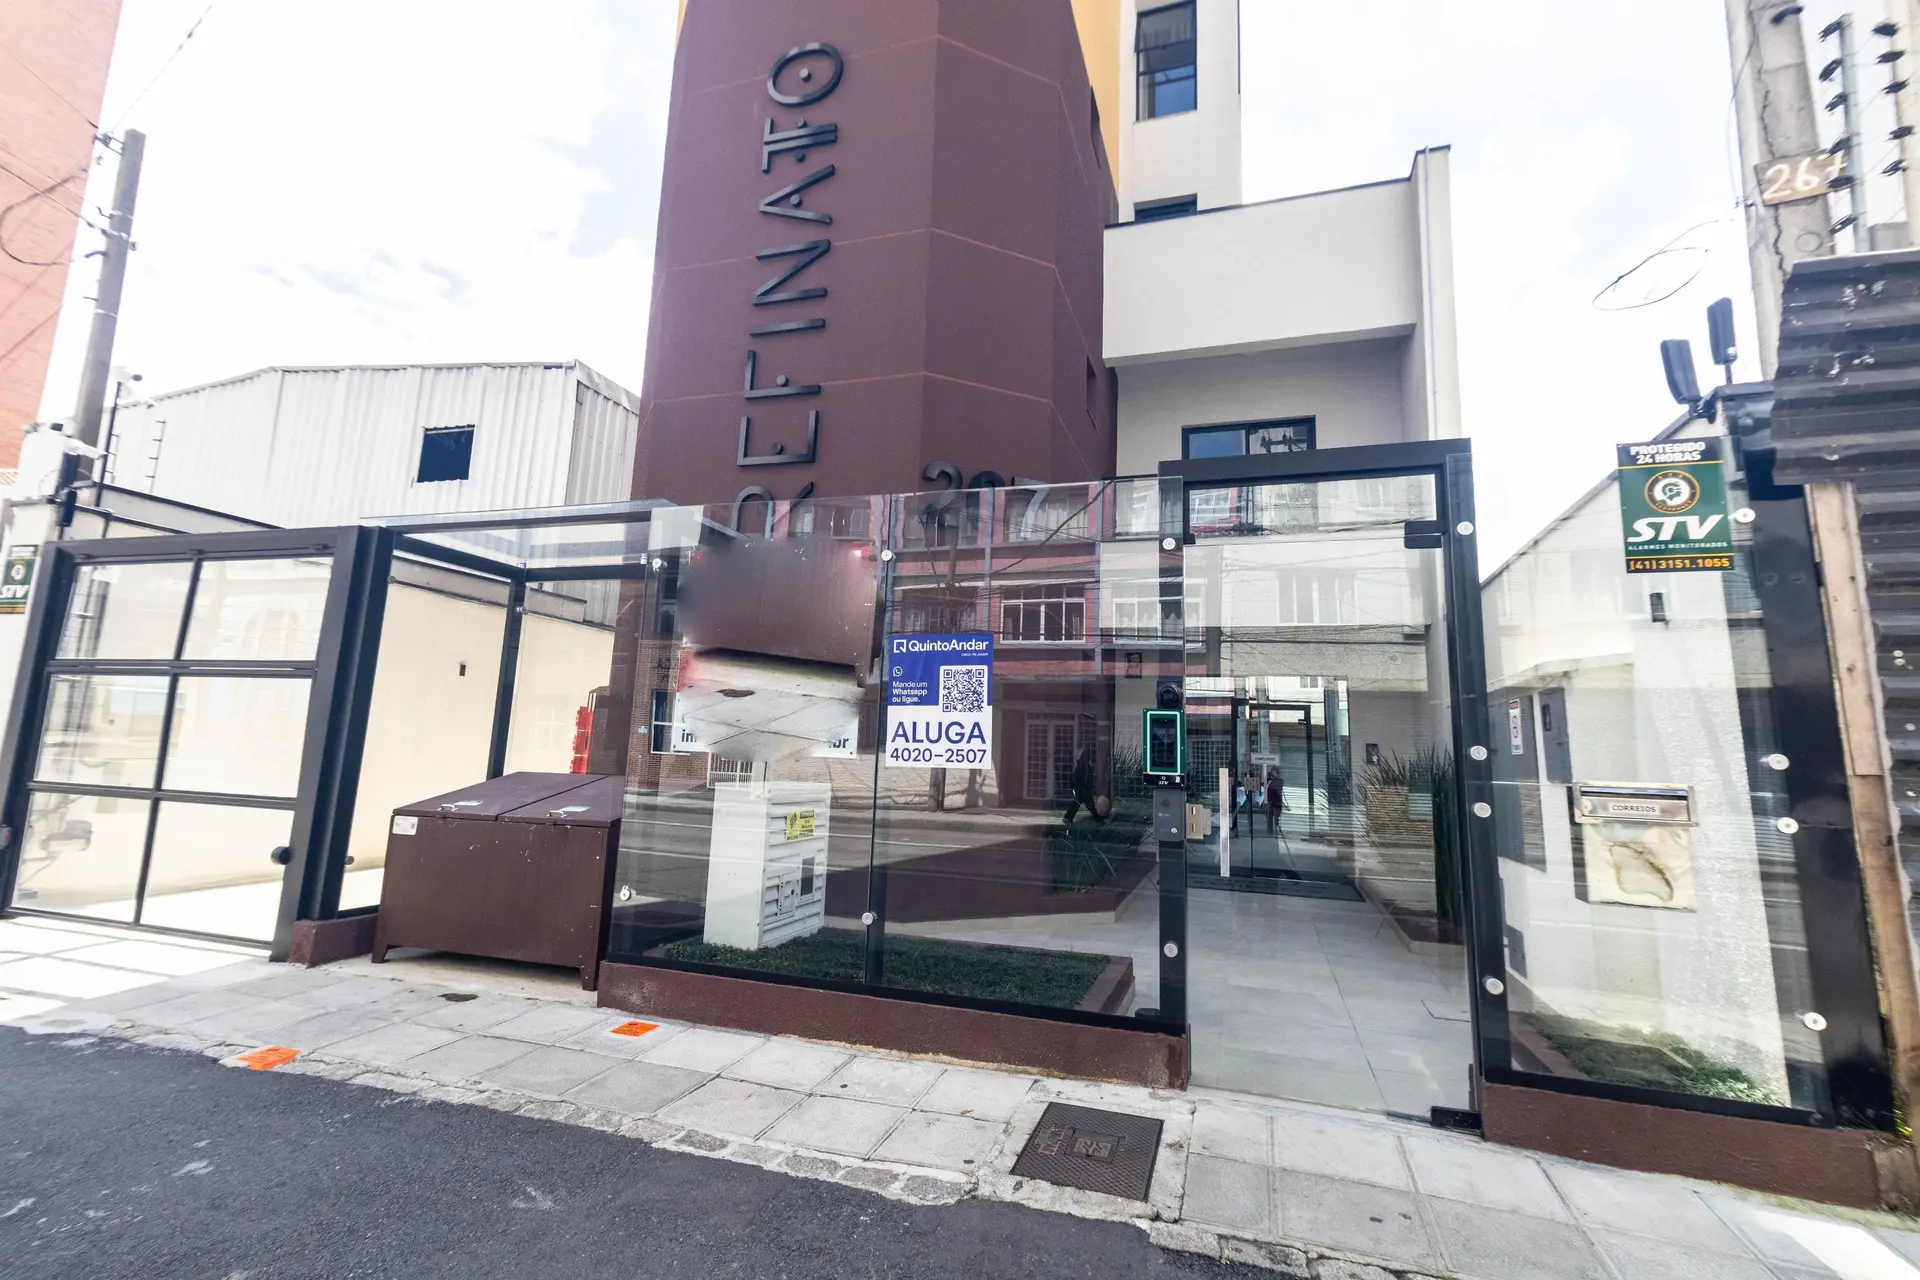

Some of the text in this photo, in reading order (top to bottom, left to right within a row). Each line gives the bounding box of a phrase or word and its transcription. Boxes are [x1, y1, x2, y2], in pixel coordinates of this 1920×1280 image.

[1636, 451, 1702, 464] 24 HORAS
[1627, 514, 1724, 542] STV
[0, 585, 29, 598] STV
[908, 639, 989, 652] QuintoAndar
[902, 696, 921, 704] ligue.
[891, 721, 986, 744] ALUGA
[890, 747, 987, 763] 4020-2507
[1612, 804, 1657, 812] CORREIOS
